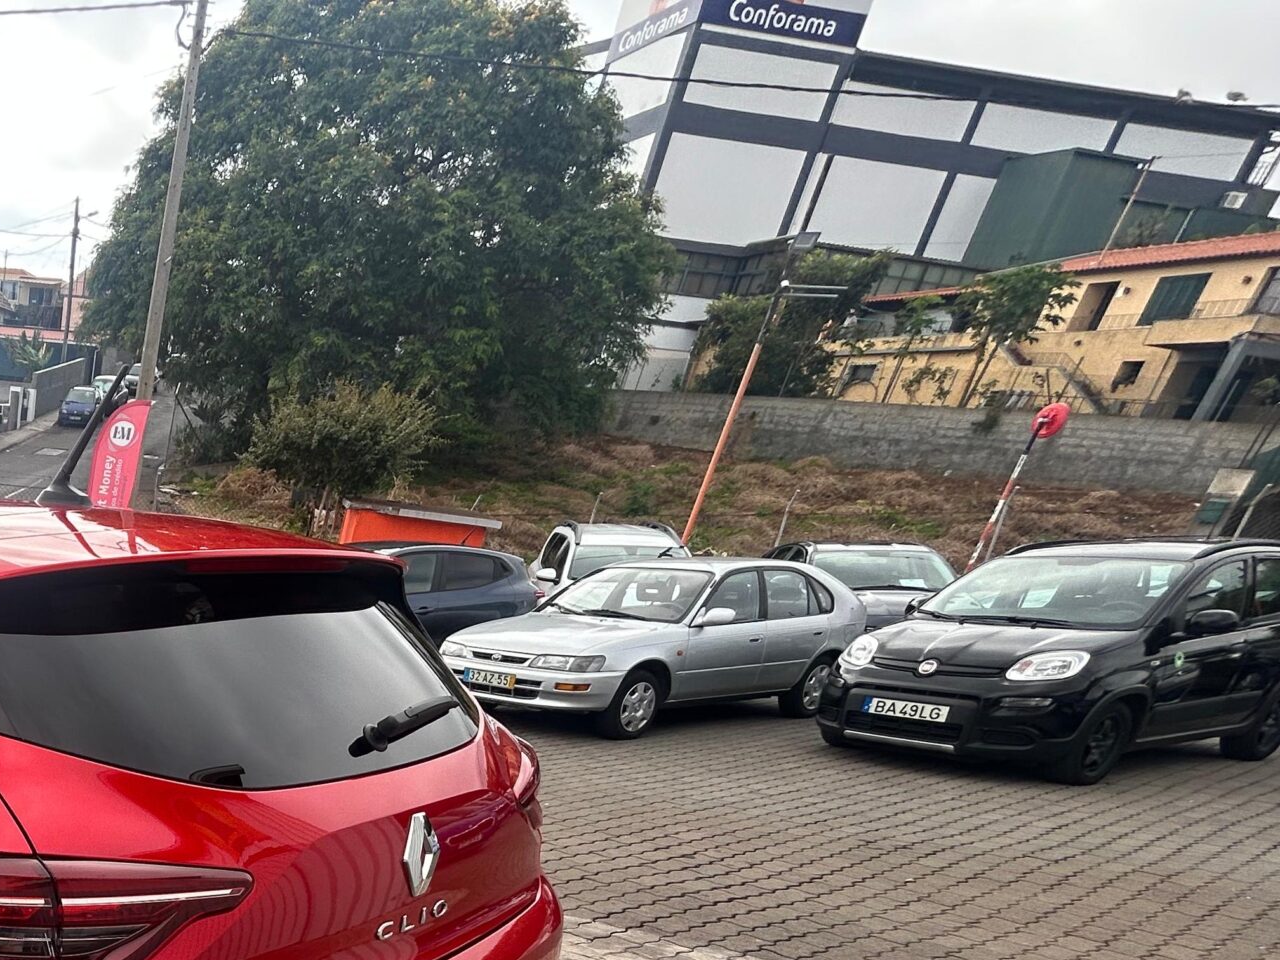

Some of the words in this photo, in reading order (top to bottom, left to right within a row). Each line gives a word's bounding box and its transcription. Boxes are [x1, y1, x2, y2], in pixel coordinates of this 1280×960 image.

[619, 7, 688, 52] Conforama
[729, 0, 837, 37] Conforama
[99, 455, 117, 495] Money
[377, 899, 448, 940] CLIO
